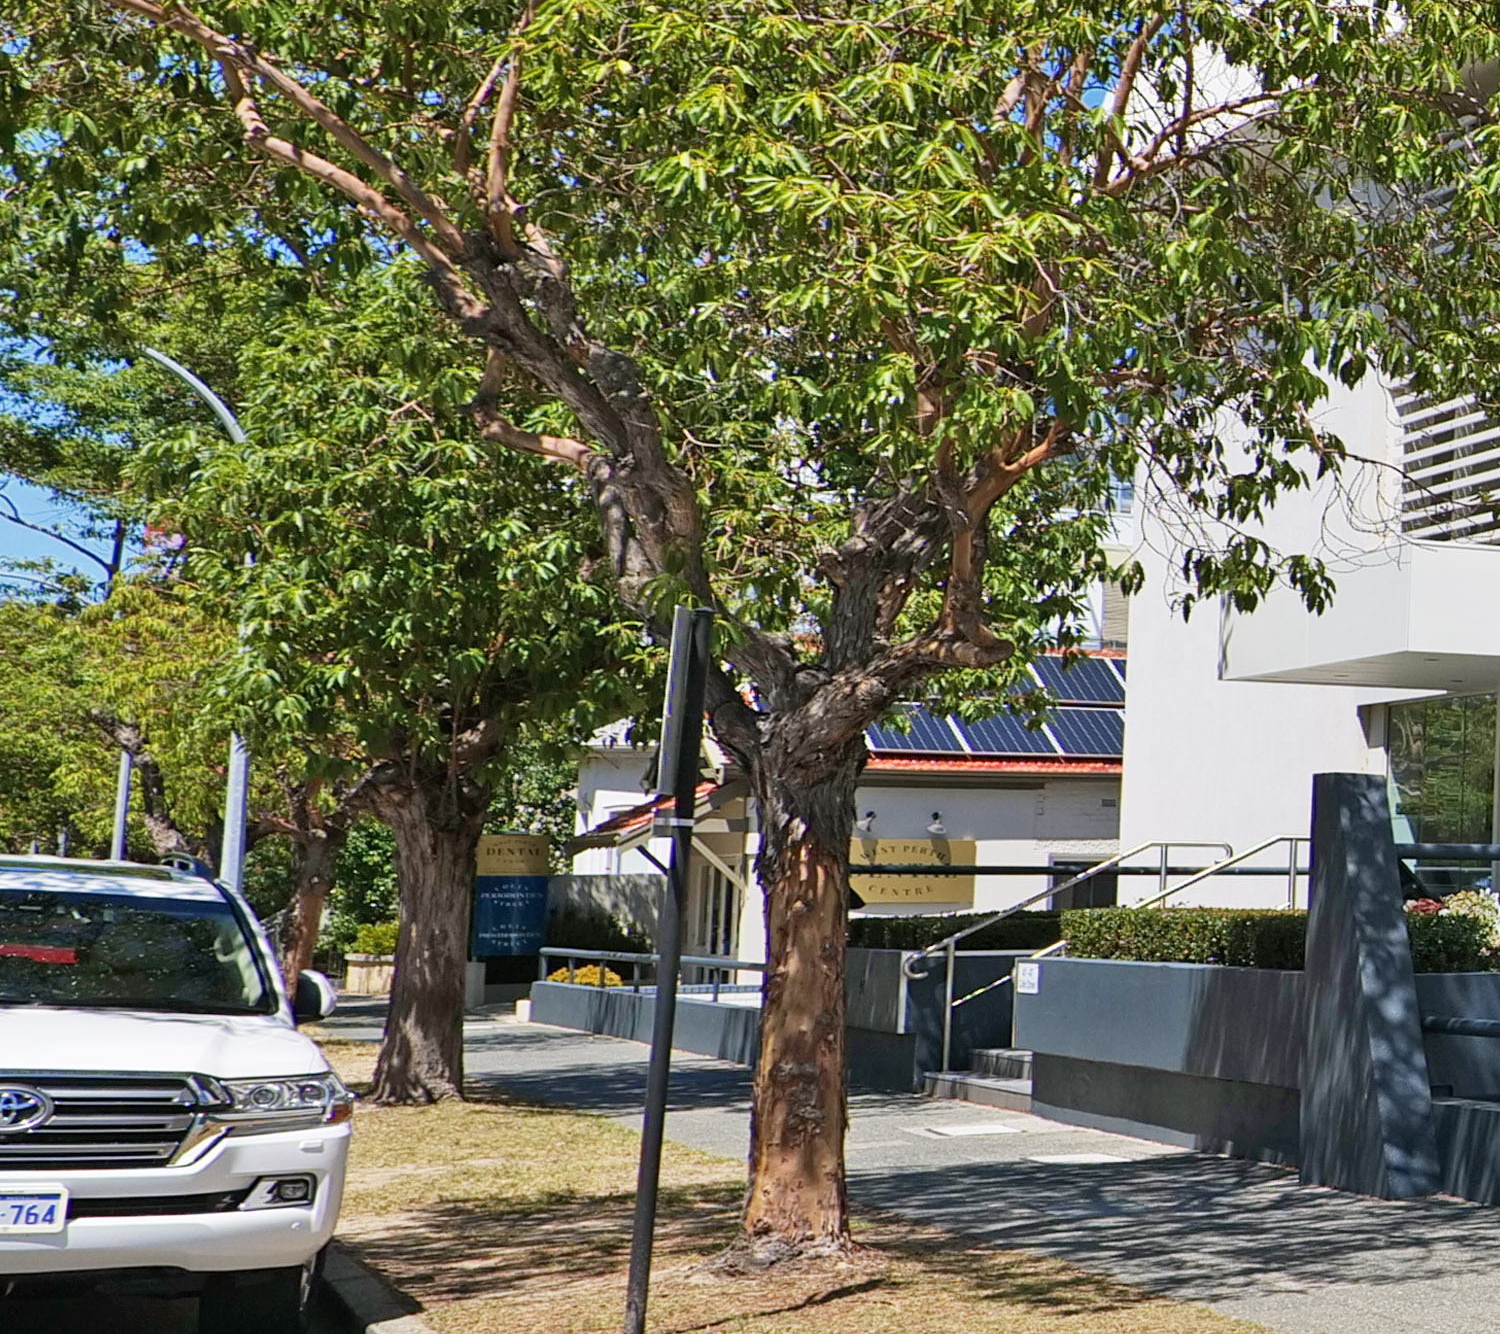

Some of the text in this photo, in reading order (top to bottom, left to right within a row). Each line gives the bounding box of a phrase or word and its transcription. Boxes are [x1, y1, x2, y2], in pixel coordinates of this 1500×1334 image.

[486, 848, 541, 856] DENTAL
[860, 845, 947, 861] WEST PERTH
[868, 885, 934, 896] CENTRE
